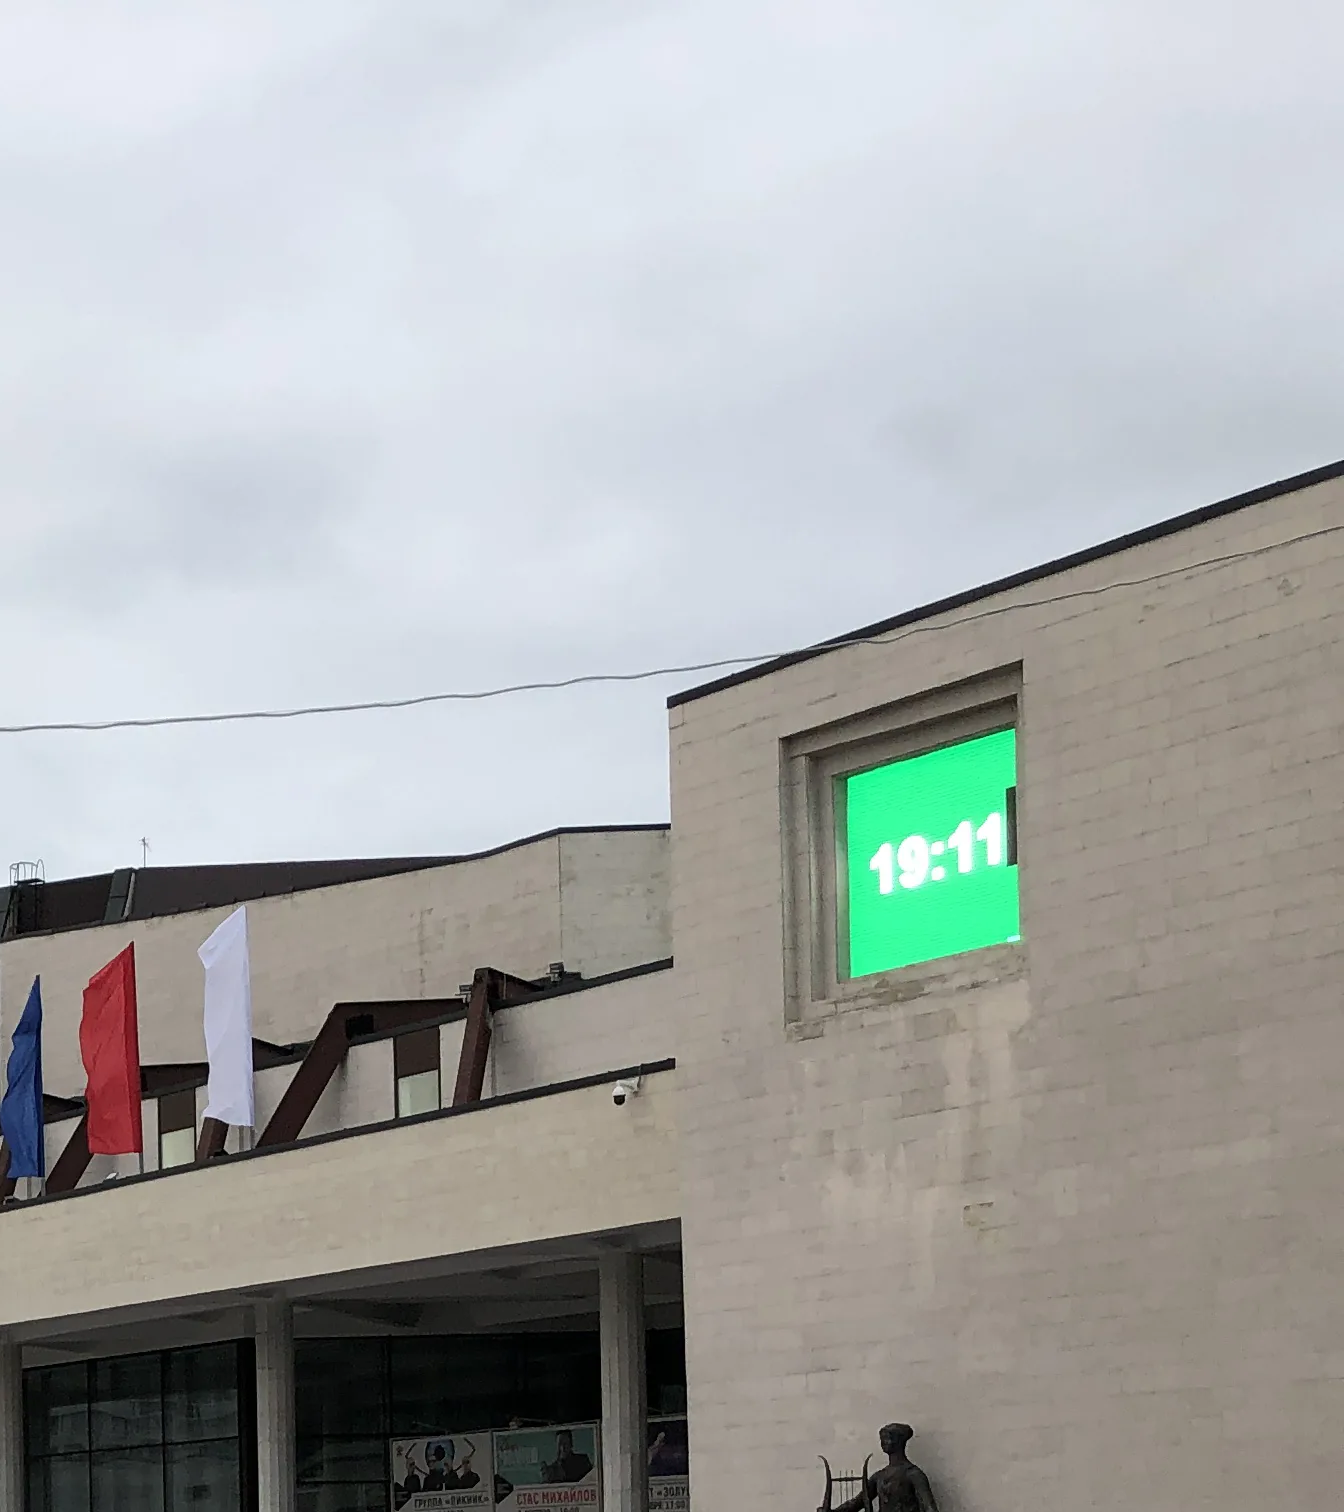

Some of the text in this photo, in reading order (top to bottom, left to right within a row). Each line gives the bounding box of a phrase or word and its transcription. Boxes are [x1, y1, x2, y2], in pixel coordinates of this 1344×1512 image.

[869, 811, 1002, 895] 19:11
[414, 1497, 443, 1508] ГРУППА
[516, 1487, 597, 1505] СТАС МИХАЙЛОВ
